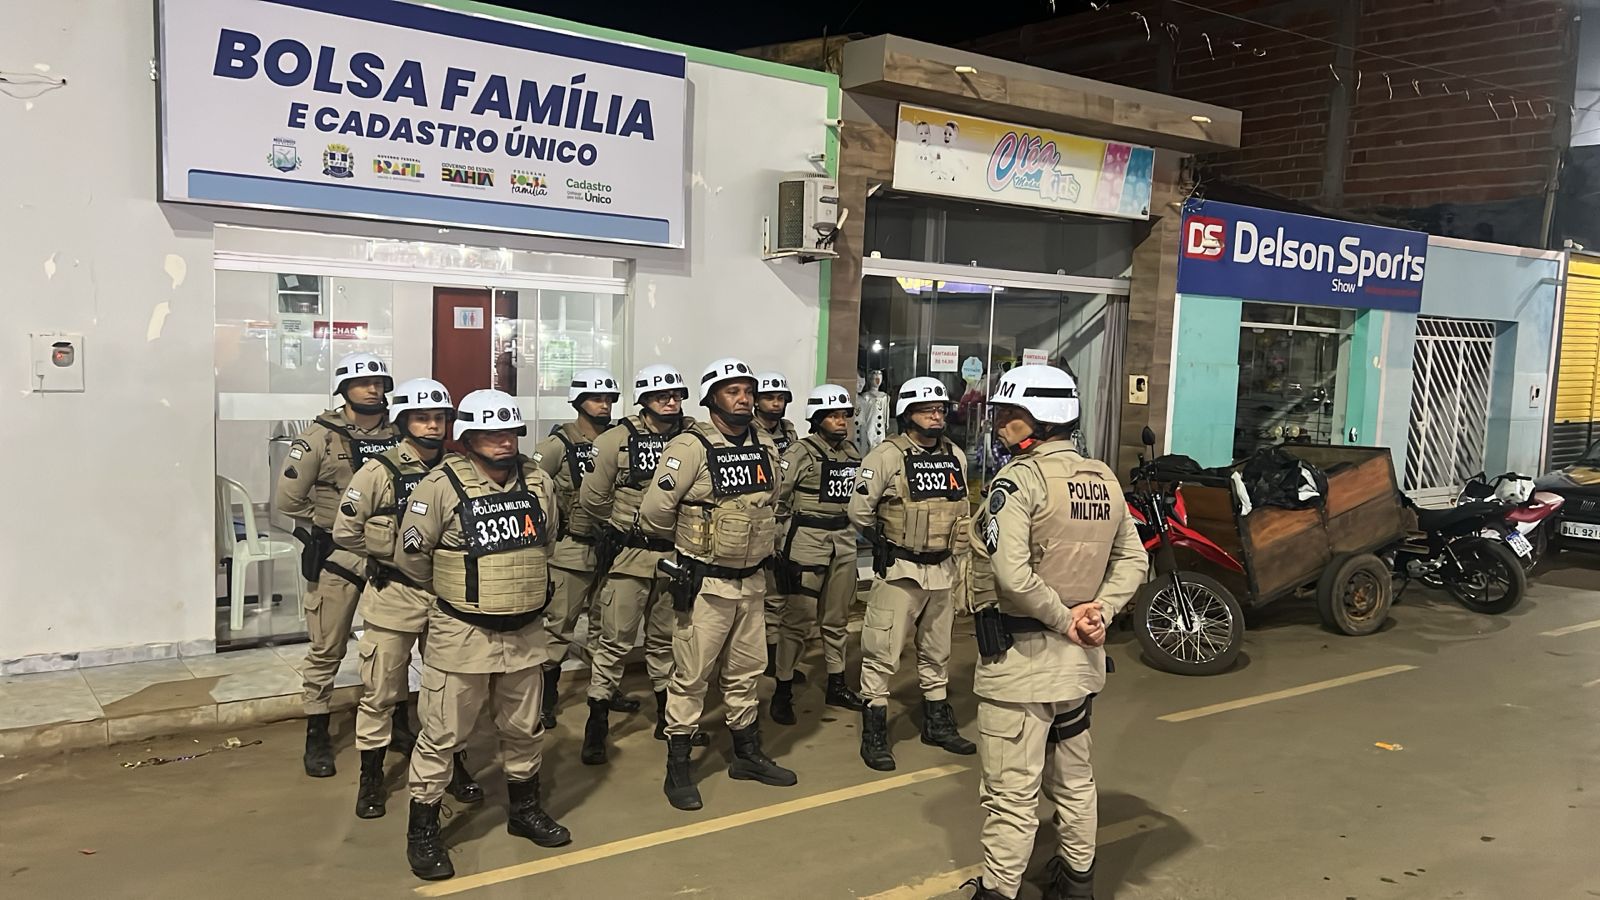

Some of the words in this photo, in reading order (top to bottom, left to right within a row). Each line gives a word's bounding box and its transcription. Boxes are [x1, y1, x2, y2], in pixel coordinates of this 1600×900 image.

[213, 28, 428, 107] BOLSA
[441, 67, 656, 141] FAMÍLIA
[288, 103, 308, 129] E
[315, 108, 498, 153] CADASTRO
[505, 126, 598, 166] ÚNICO
[441, 168, 494, 187] BAHIA
[566, 178, 612, 192] Cadastro
[584, 190, 612, 204] Único
[1187, 221, 1223, 256] DS
[1233, 220, 1335, 273] Delson
[1337, 236, 1425, 287] Sports
[1331, 278, 1356, 293] Show
[359, 444, 386, 454] POLÍCIA
[638, 440, 662, 449] POLÍCIA
[717, 452, 741, 463] POLÍCIA
[741, 451, 762, 462] MILITAR
[912, 461, 934, 469] POLÍCIA
[934, 461, 955, 469] MILITAR
[719, 464, 752, 487] 3331
[756, 464, 767, 484] A
[916, 473, 948, 491] 3332
[949, 472, 960, 490] A
[1067, 480, 1110, 500] POLÍCIA
[472, 502, 504, 516] POLÍCIA
[505, 500, 532, 511] MILITAR
[1070, 502, 1110, 520] MILITAR
[476, 515, 520, 546] 3330
[524, 514, 537, 537] A
